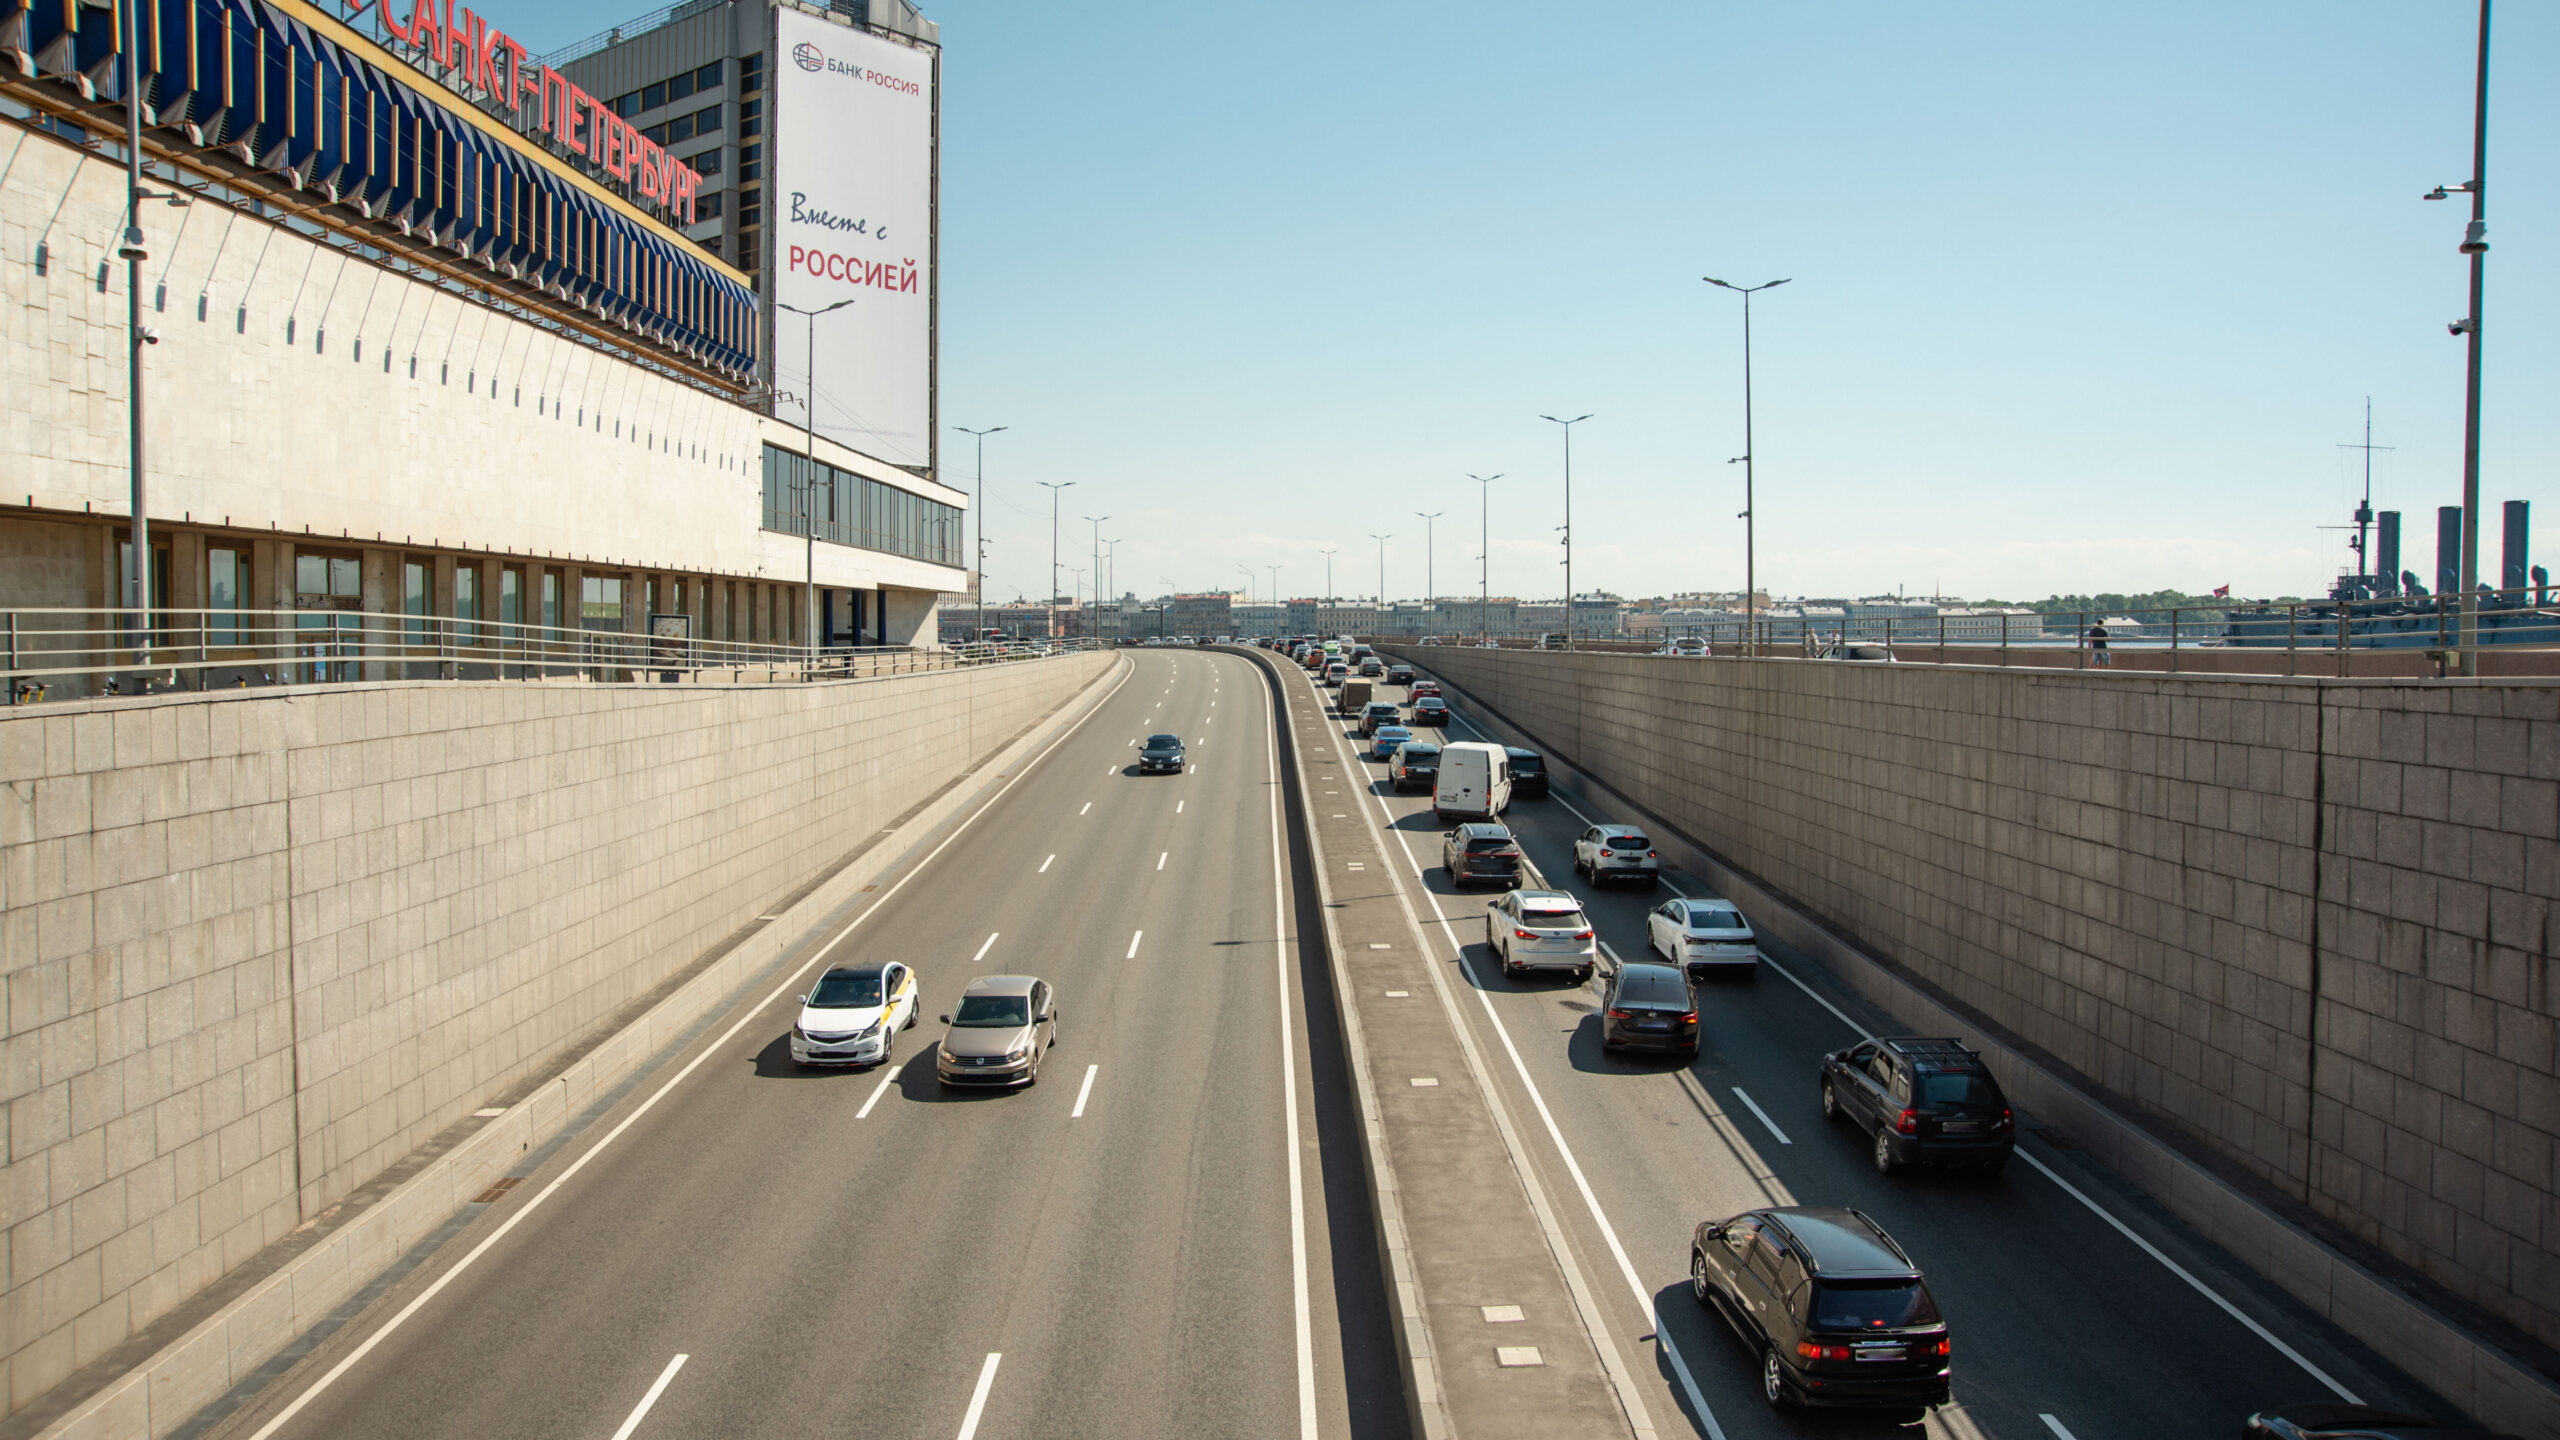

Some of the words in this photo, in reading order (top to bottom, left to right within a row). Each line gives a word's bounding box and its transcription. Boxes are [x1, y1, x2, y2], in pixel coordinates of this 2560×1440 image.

[827, 58, 863, 80] БАНК
[866, 70, 920, 96] РОССИЯ
[790, 192, 866, 234] Вместе
[876, 226, 887, 240] с
[789, 245, 917, 294] РОССИЕЙ
